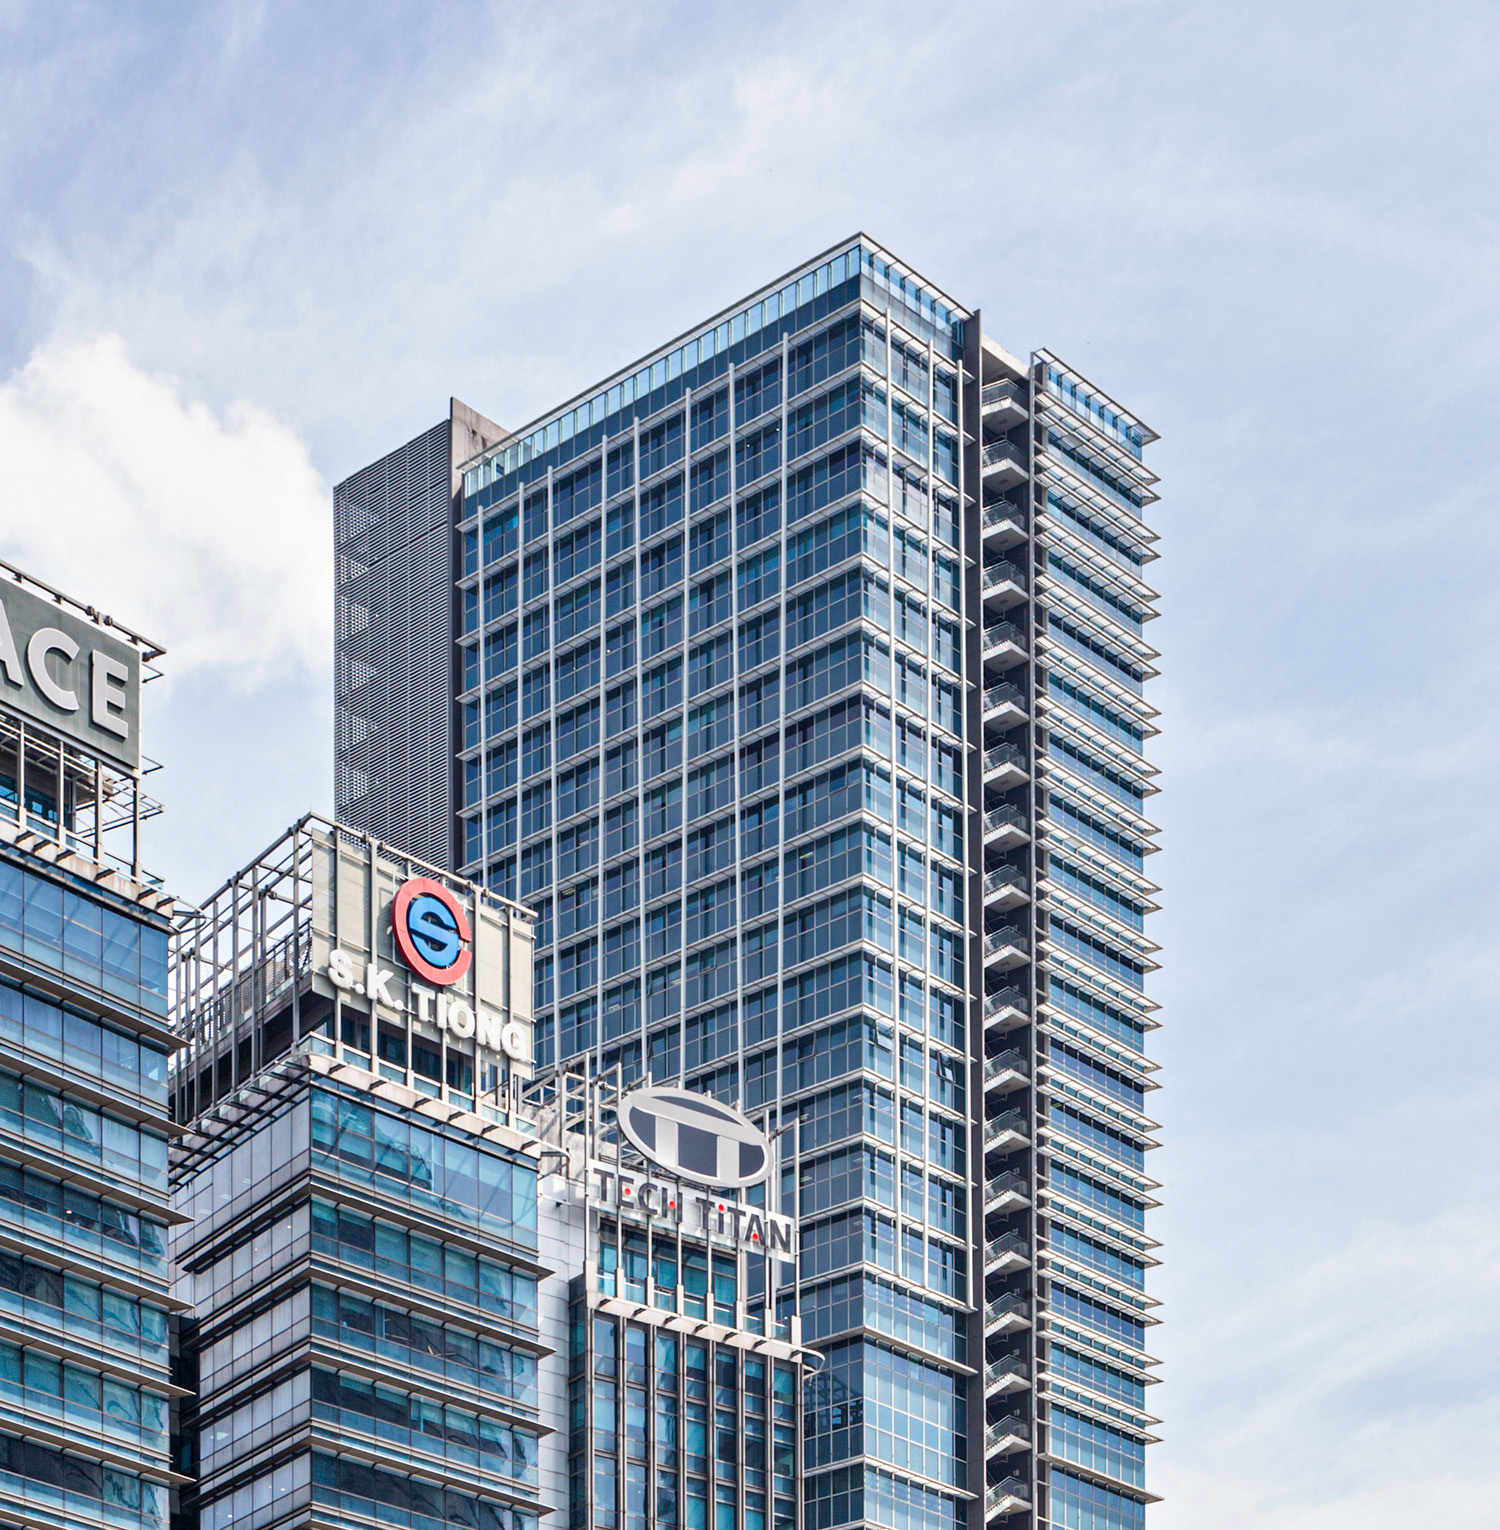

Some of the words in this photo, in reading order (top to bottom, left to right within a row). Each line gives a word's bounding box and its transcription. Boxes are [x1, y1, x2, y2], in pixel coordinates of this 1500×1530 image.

[327, 949, 405, 1011] S.K.
[411, 983, 528, 1061] TIONG
[594, 1168, 683, 1223] TECH
